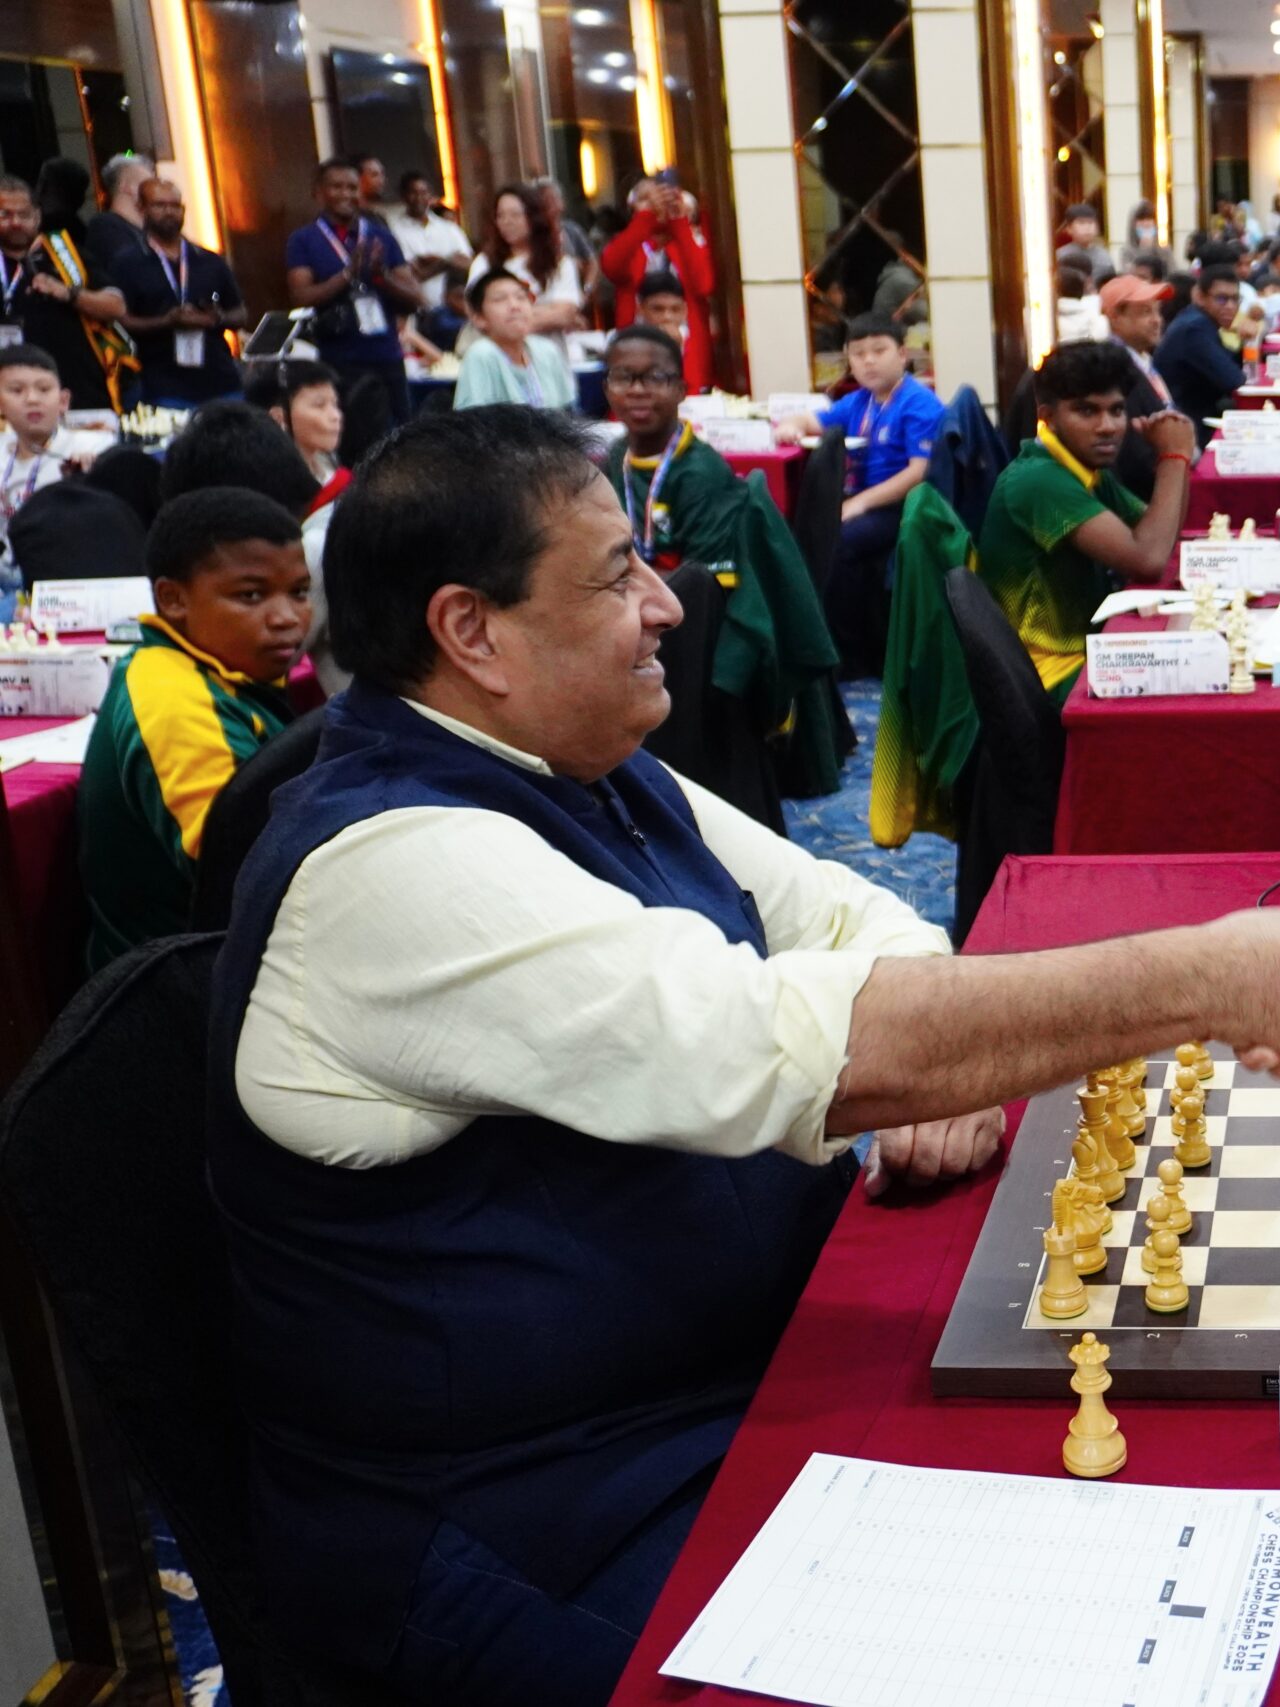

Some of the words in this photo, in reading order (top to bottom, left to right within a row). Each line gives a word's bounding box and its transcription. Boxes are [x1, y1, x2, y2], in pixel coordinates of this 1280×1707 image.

[1115, 652, 1155, 660] DEEPAN
[1262, 1534, 1278, 1564] CHESS
[1242, 1568, 1269, 1640] CHAMPIONSHIP
[1232, 1644, 1248, 1671] 2025
